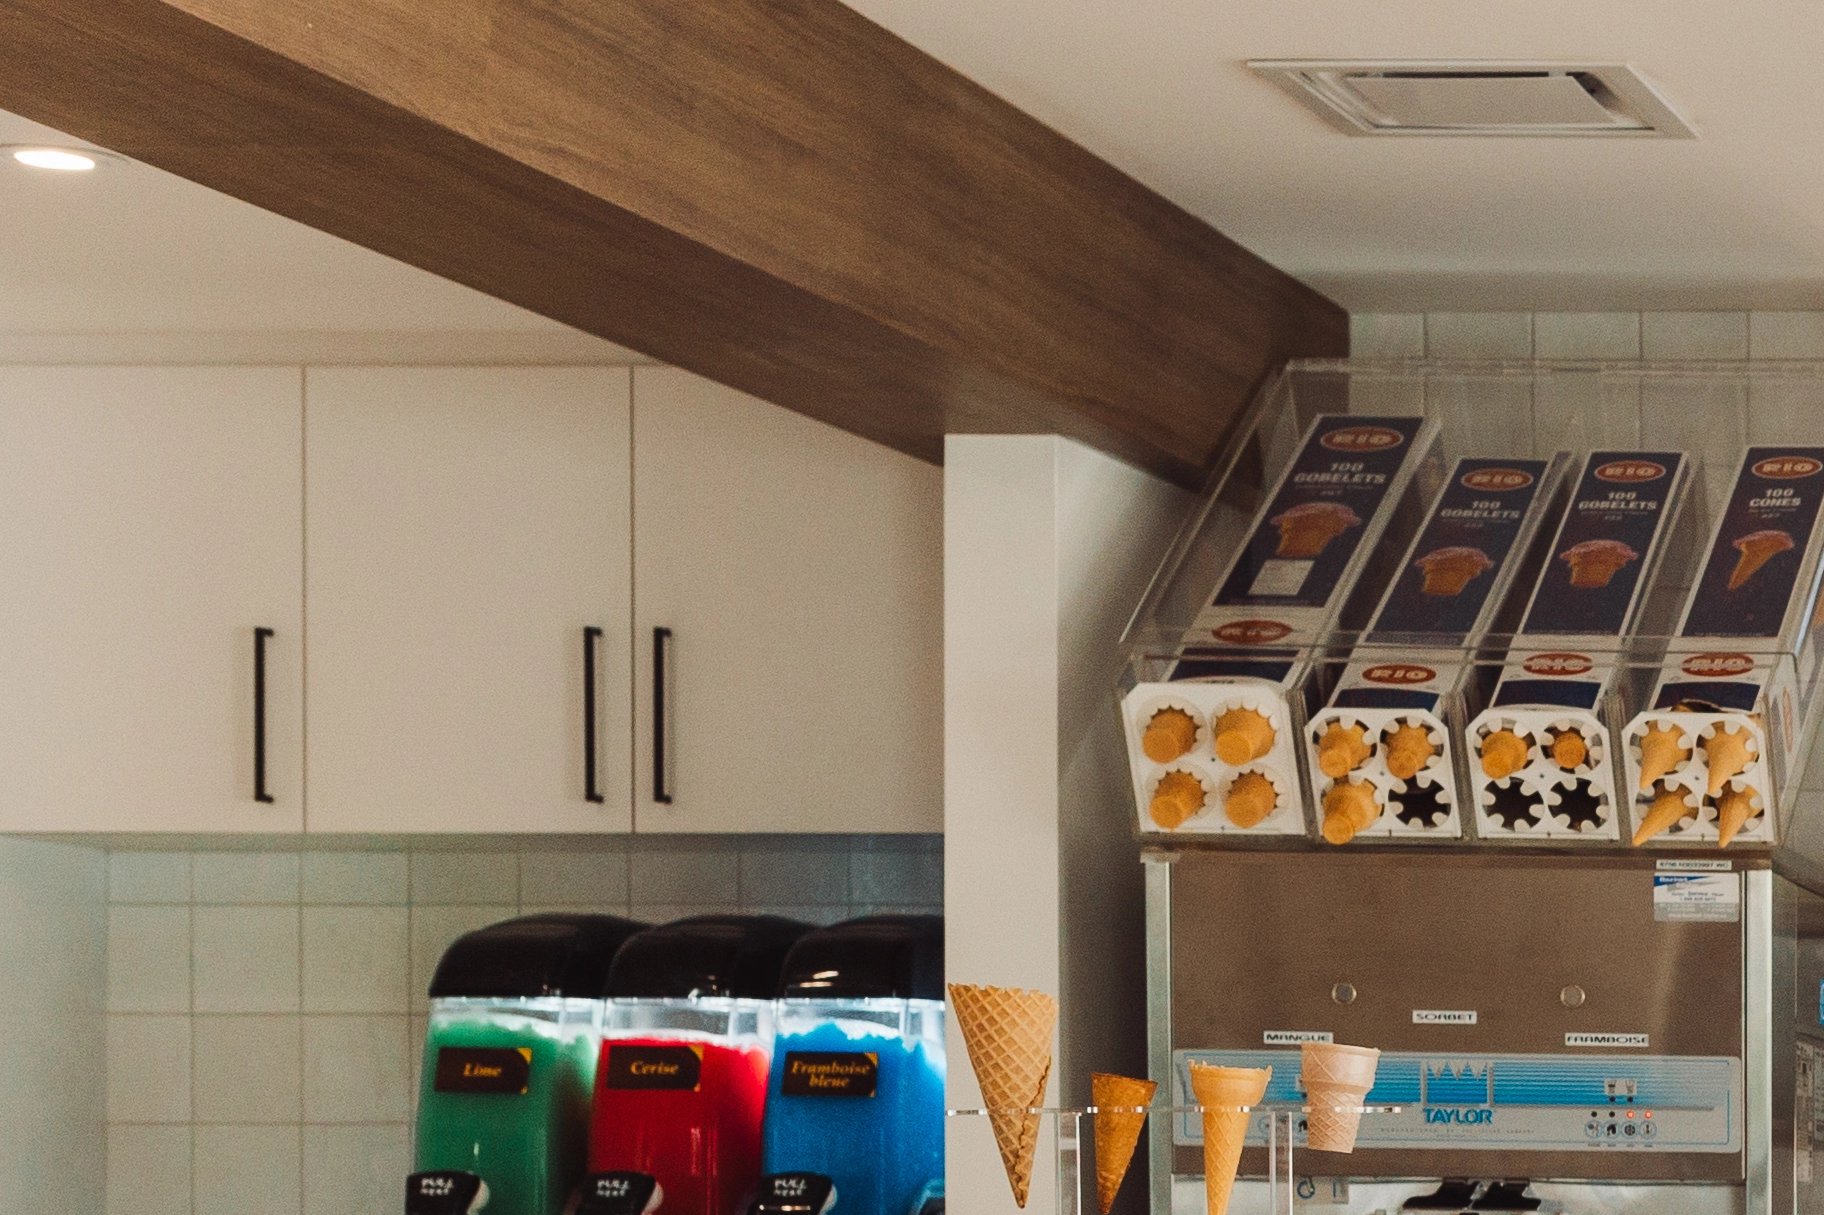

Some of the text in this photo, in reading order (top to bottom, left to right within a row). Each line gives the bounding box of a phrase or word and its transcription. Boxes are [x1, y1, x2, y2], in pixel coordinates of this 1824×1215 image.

[1332, 432, 1395, 446] RIO
[1331, 462, 1364, 472] 100
[1604, 467, 1656, 476] RIO
[1762, 462, 1813, 472] RIO
[1294, 473, 1387, 484] GOBELETS
[1471, 474, 1524, 485] RIO
[1607, 491, 1637, 500] 100
[1765, 488, 1794, 497] 100
[1472, 500, 1501, 509] 100
[1578, 501, 1656, 510] GOBELETS
[1750, 498, 1801, 507] CONES
[1440, 509, 1520, 519] GOBELETS
[1371, 669, 1427, 680] RIO
[1416, 1013, 1474, 1021] SORBET
[1266, 1033, 1331, 1042] MANGUE
[1567, 1035, 1647, 1044] FRAMBOISE
[463, 1062, 503, 1077] Lime
[631, 1061, 679, 1076] Cerise
[791, 1061, 870, 1077] Framboise
[809, 1075, 849, 1089] bleue
[1423, 1108, 1493, 1125] TAYLOR
[421, 1178, 455, 1189] PULL
[597, 1179, 631, 1190] PULL
[774, 1179, 808, 1190] PULL
